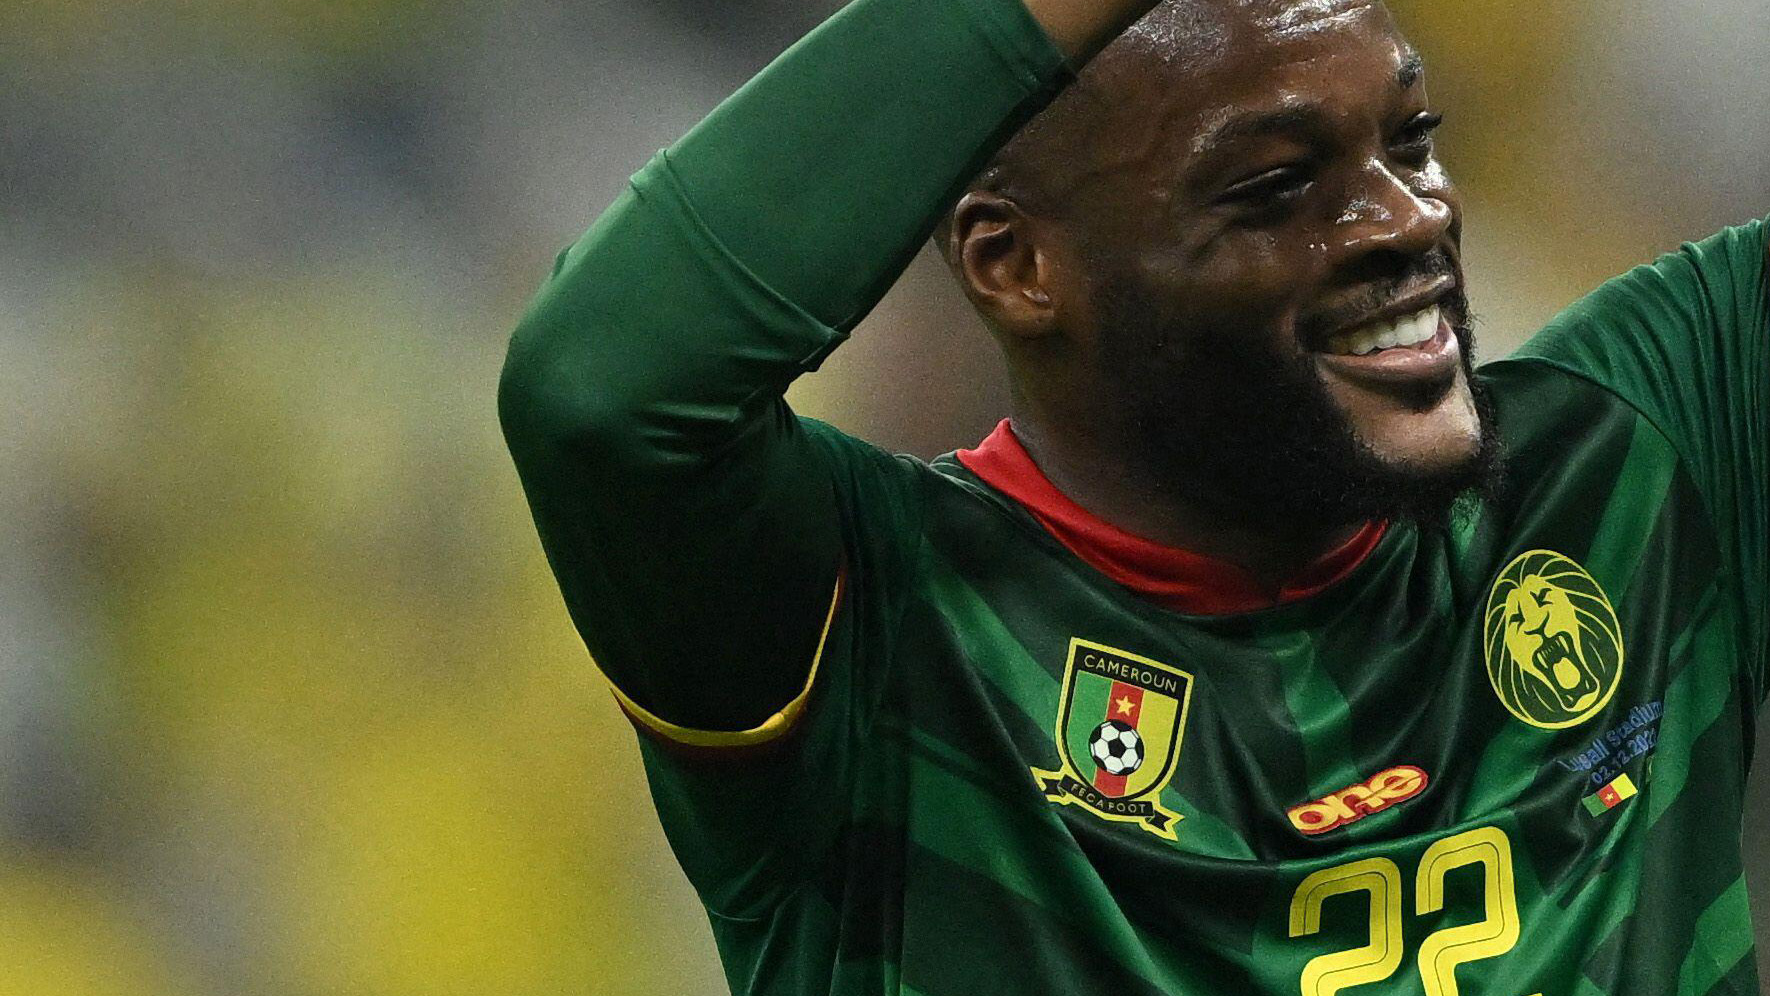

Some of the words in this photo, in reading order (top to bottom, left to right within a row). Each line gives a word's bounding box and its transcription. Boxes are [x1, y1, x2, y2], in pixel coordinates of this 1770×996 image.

[1083, 654, 1178, 694] CAMEROUN
[1606, 701, 1662, 746] Sadium
[1070, 782, 1147, 815] FECAFOOT
[1287, 766, 1427, 834] one
[1288, 825, 1543, 996] 22
